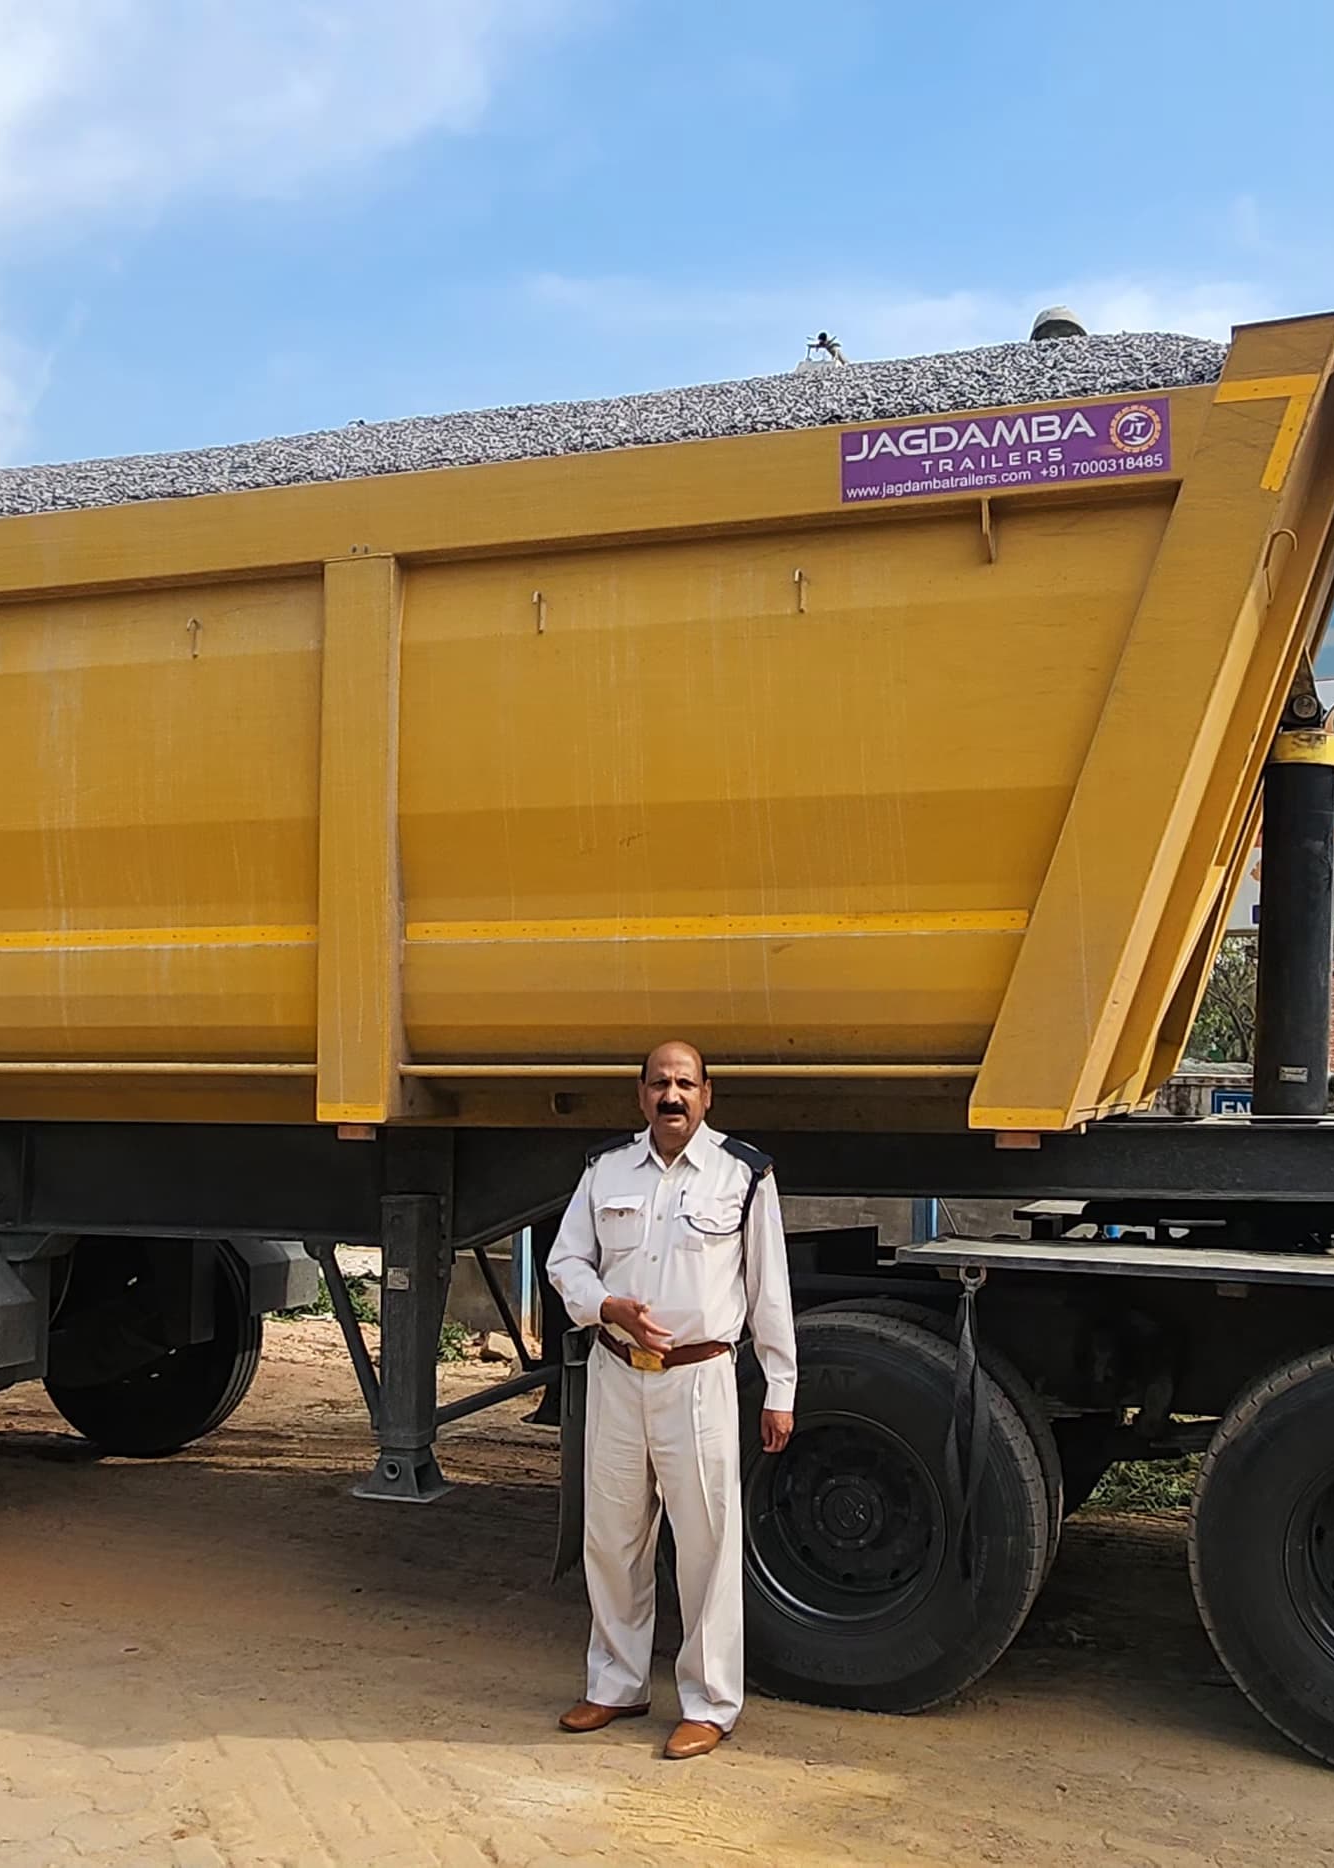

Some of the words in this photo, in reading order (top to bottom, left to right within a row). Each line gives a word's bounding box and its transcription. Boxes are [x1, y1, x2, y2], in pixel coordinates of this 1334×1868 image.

[845, 411, 1097, 462] JAGDAMBA
[846, 469, 1032, 498] www.jagdambatrailers.com
[1040, 464, 1067, 478] +91
[1072, 453, 1164, 476] 7000318485
[921, 447, 1063, 474] TRAILERS
